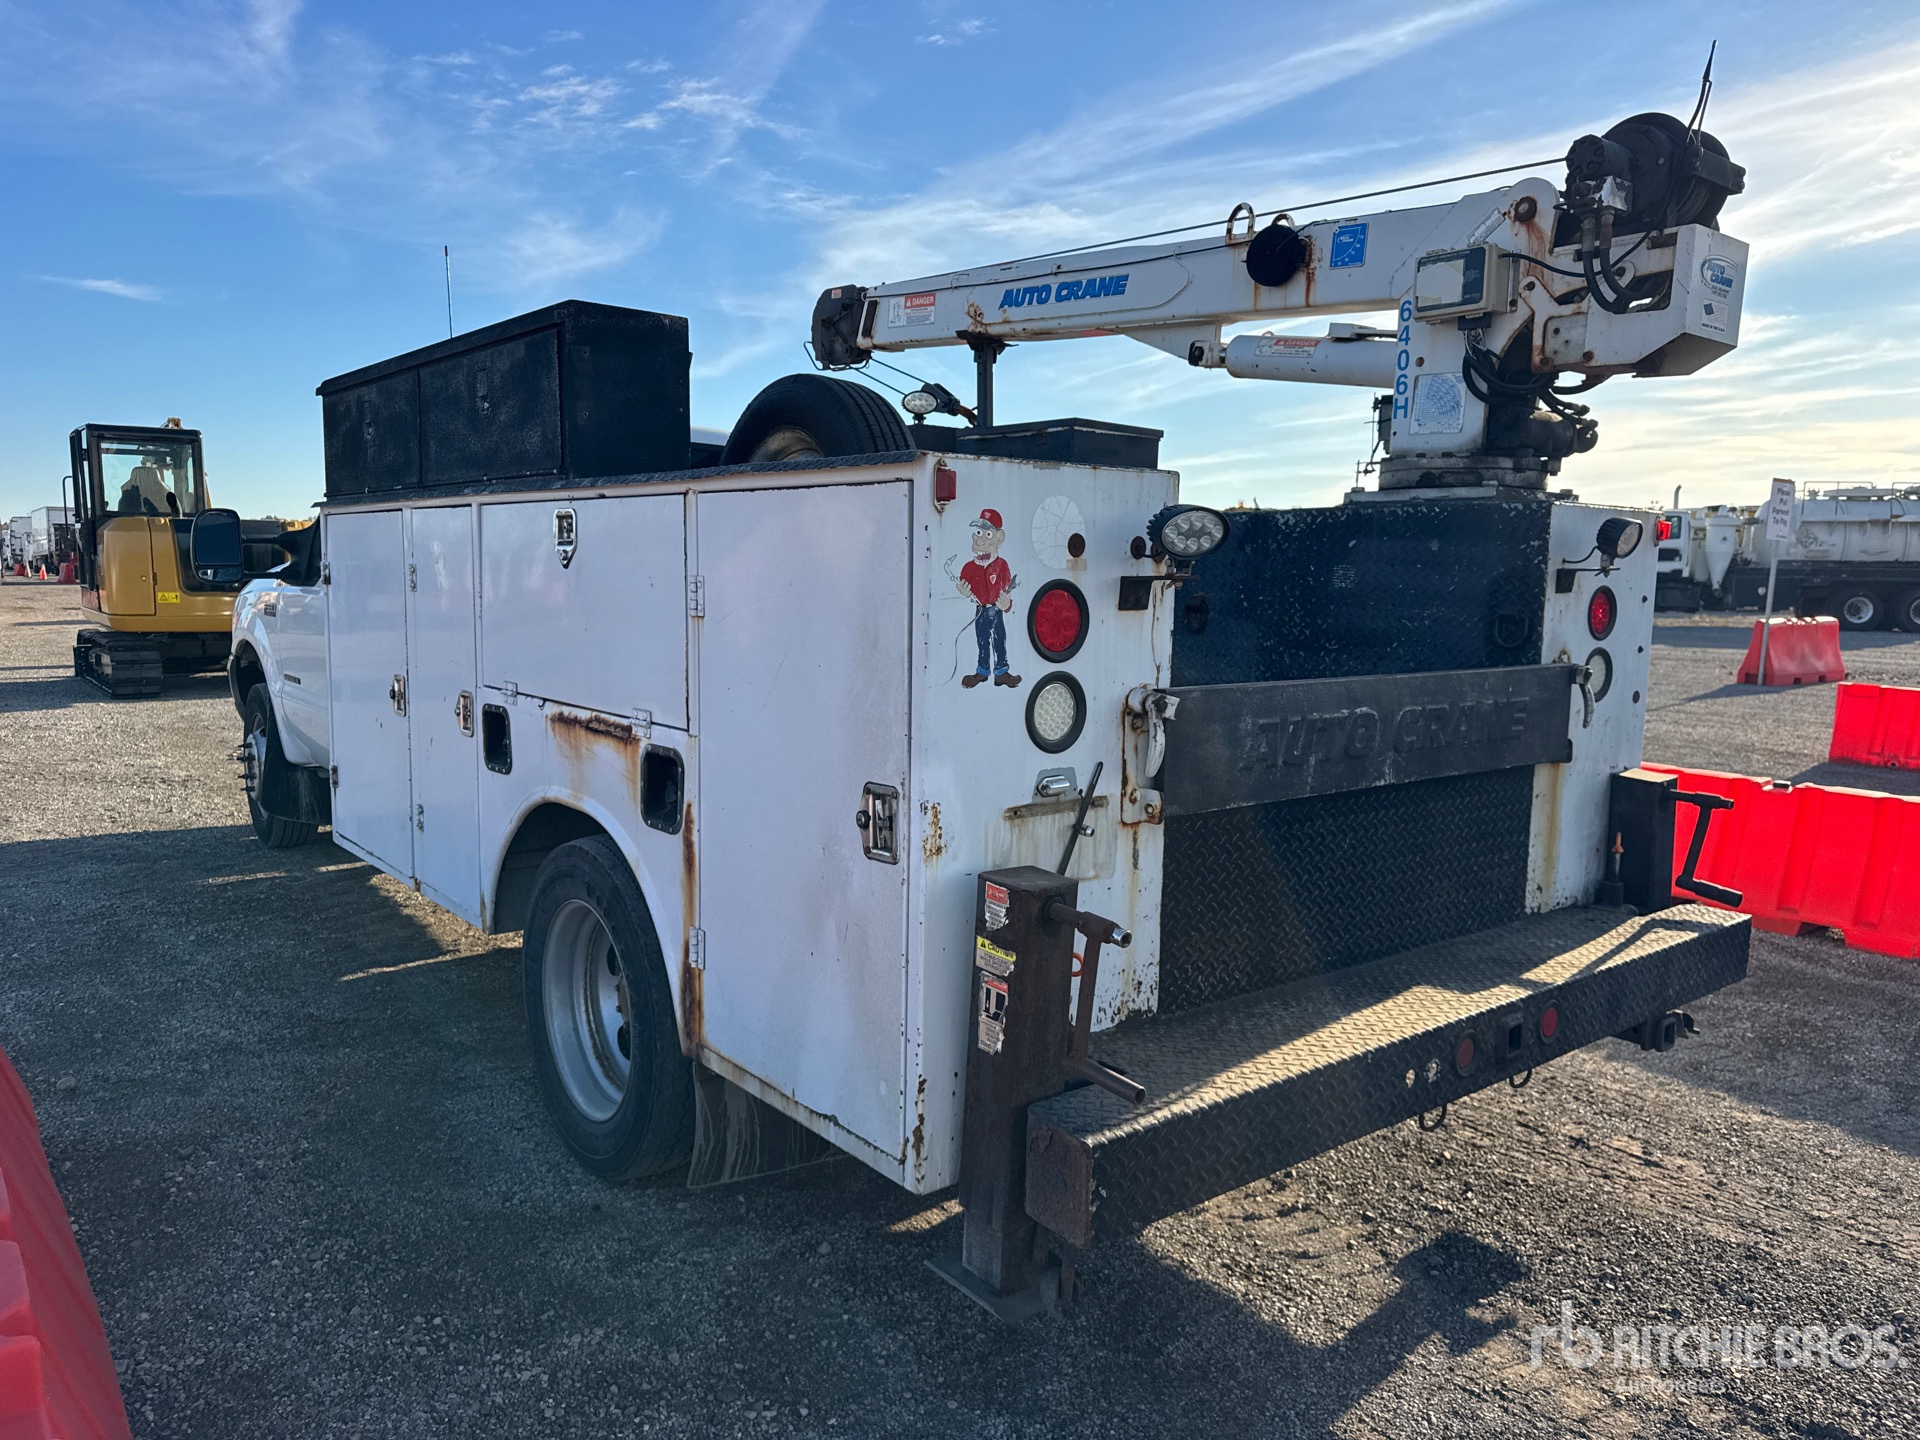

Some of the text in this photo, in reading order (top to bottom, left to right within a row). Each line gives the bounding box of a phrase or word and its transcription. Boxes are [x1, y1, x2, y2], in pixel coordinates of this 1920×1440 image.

[1707, 261, 1725, 275] AUTO
[1711, 273, 1733, 288] CRANE
[999, 274, 1129, 309] AUTO CRANE
[912, 295, 935, 306] DANGER
[1393, 300, 1412, 419] 6406H
[987, 942, 1014, 959] CAUTION
